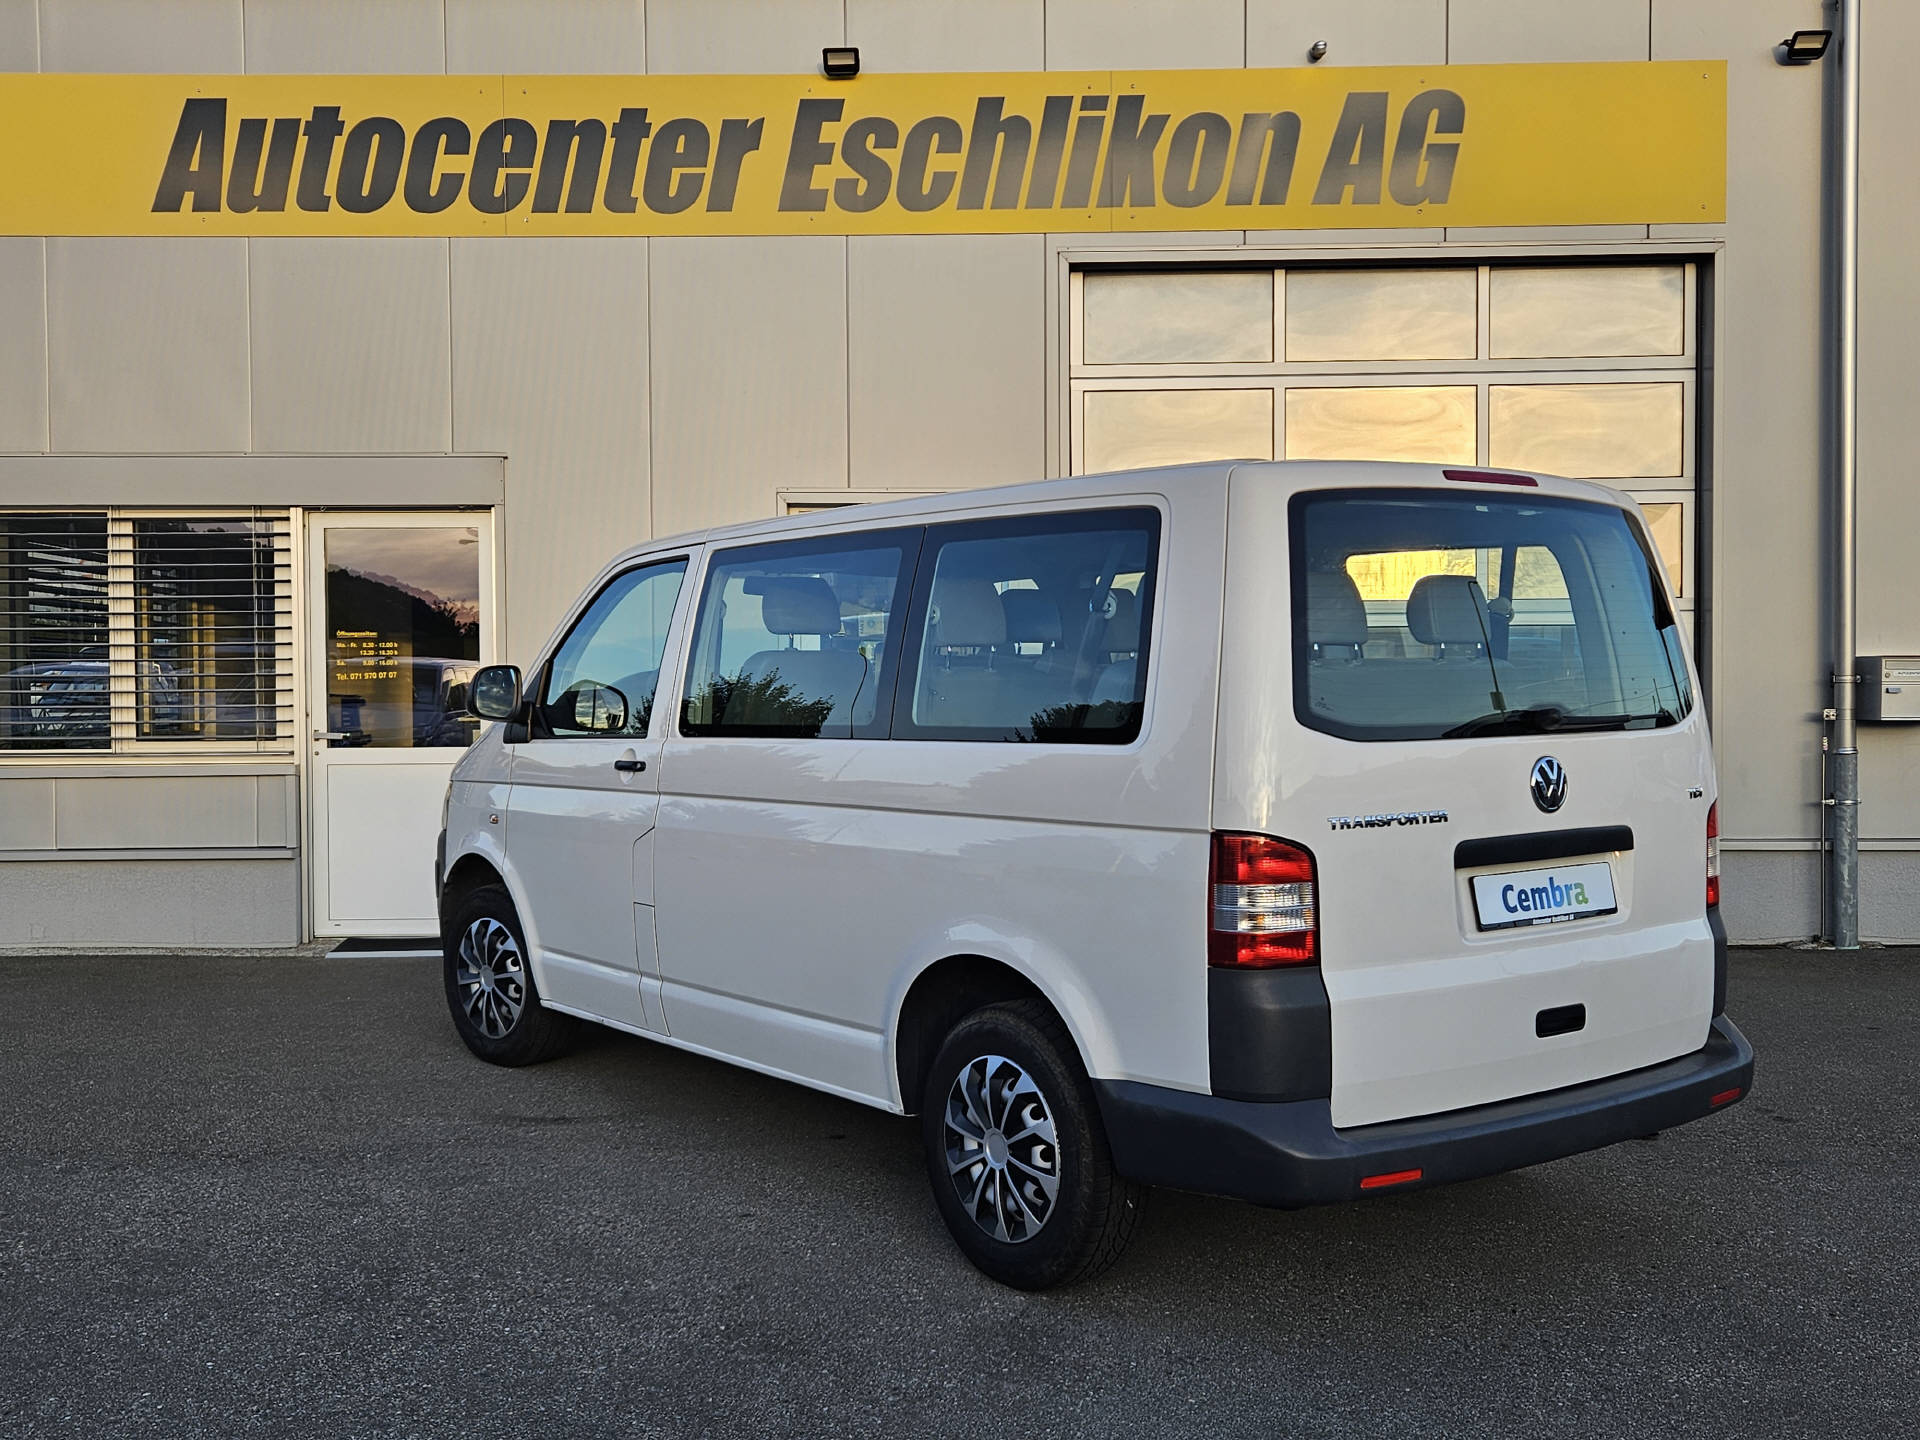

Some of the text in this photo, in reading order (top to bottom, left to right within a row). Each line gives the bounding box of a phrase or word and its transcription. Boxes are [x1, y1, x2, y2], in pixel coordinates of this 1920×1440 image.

[151, 89, 1466, 213] Autocenter Eschlikon AG
[1328, 809, 1449, 831] TRANSPORTER
[1502, 876, 1589, 913] Cembra
